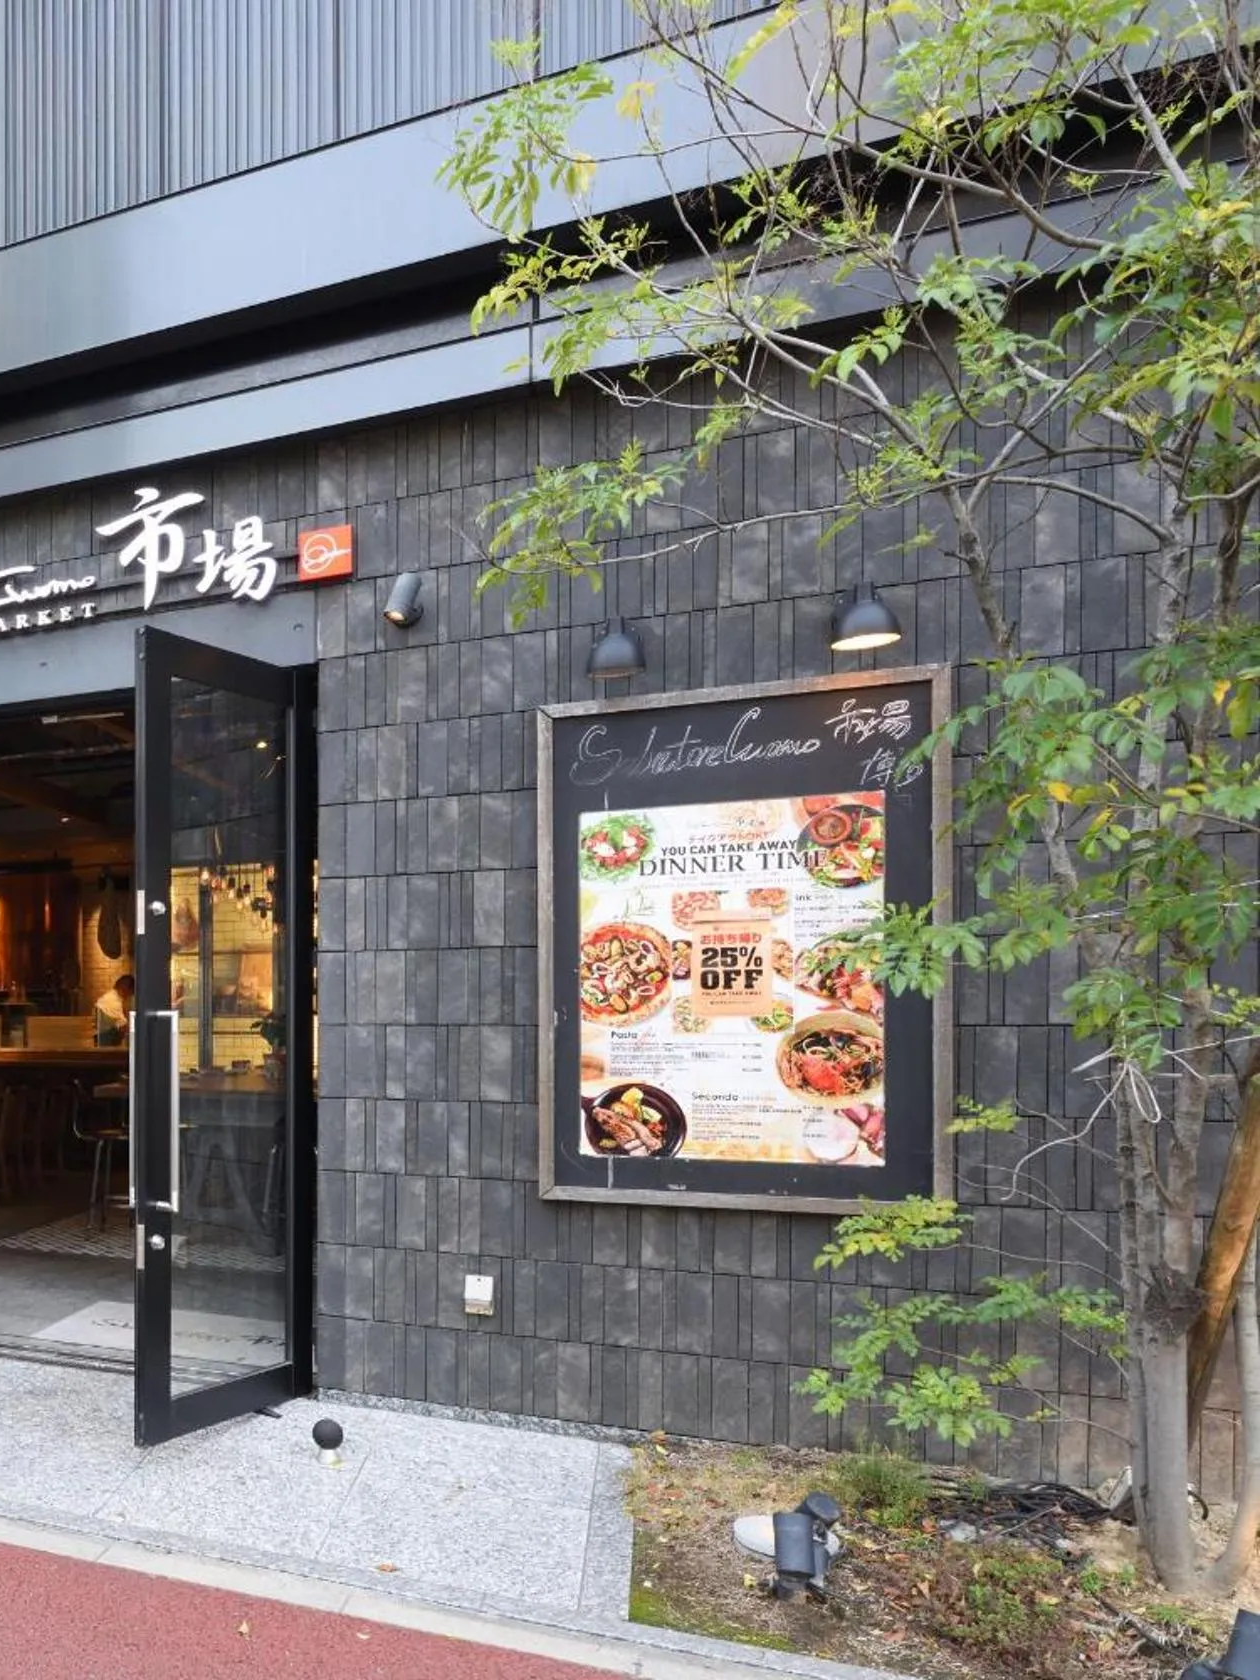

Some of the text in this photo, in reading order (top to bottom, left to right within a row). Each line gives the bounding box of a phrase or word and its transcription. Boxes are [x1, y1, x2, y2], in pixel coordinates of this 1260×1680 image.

[95, 487, 277, 611] 市場
[661, 839, 797, 857] YOU CAN TAKE AWAY
[639, 850, 828, 876] DINNER TIME
[701, 946, 763, 968] 25%
[700, 969, 764, 991] OFF
